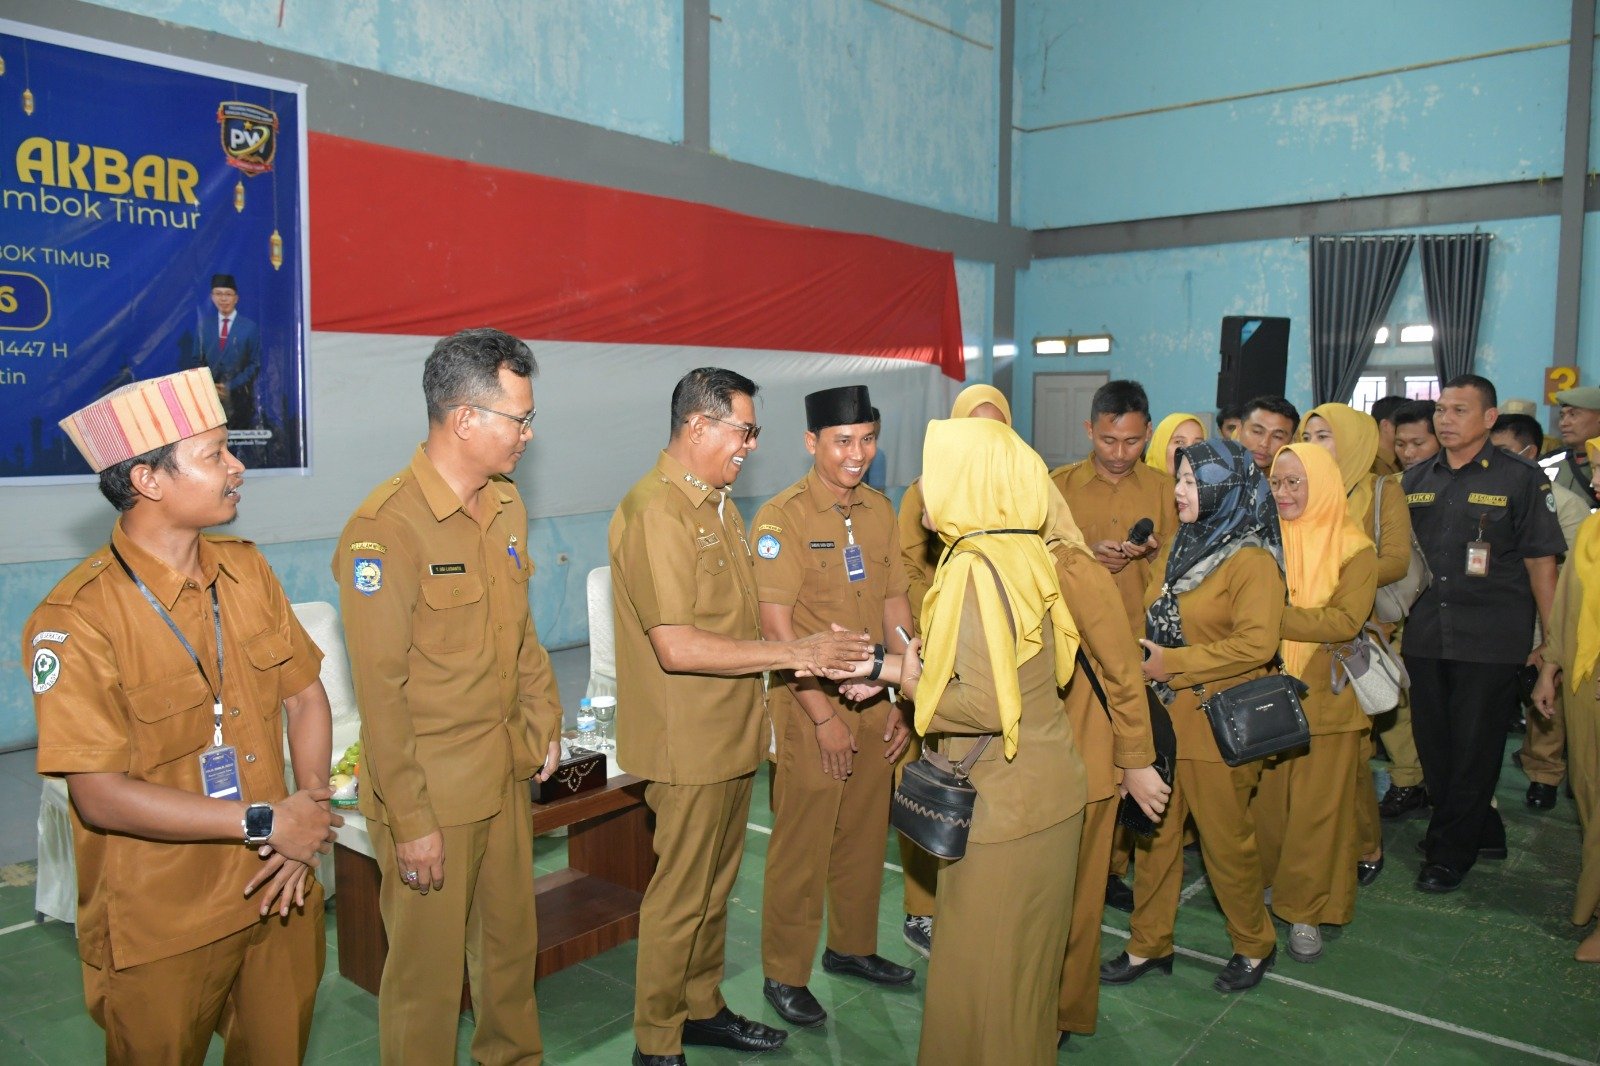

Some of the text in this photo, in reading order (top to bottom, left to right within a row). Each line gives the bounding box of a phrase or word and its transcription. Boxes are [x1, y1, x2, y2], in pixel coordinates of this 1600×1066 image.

[16, 136, 200, 206] AKBAR
[3, 187, 201, 230] mbok Timur
[0, 244, 110, 269] OK TIMUR
[0, 340, 68, 358] 1447 H
